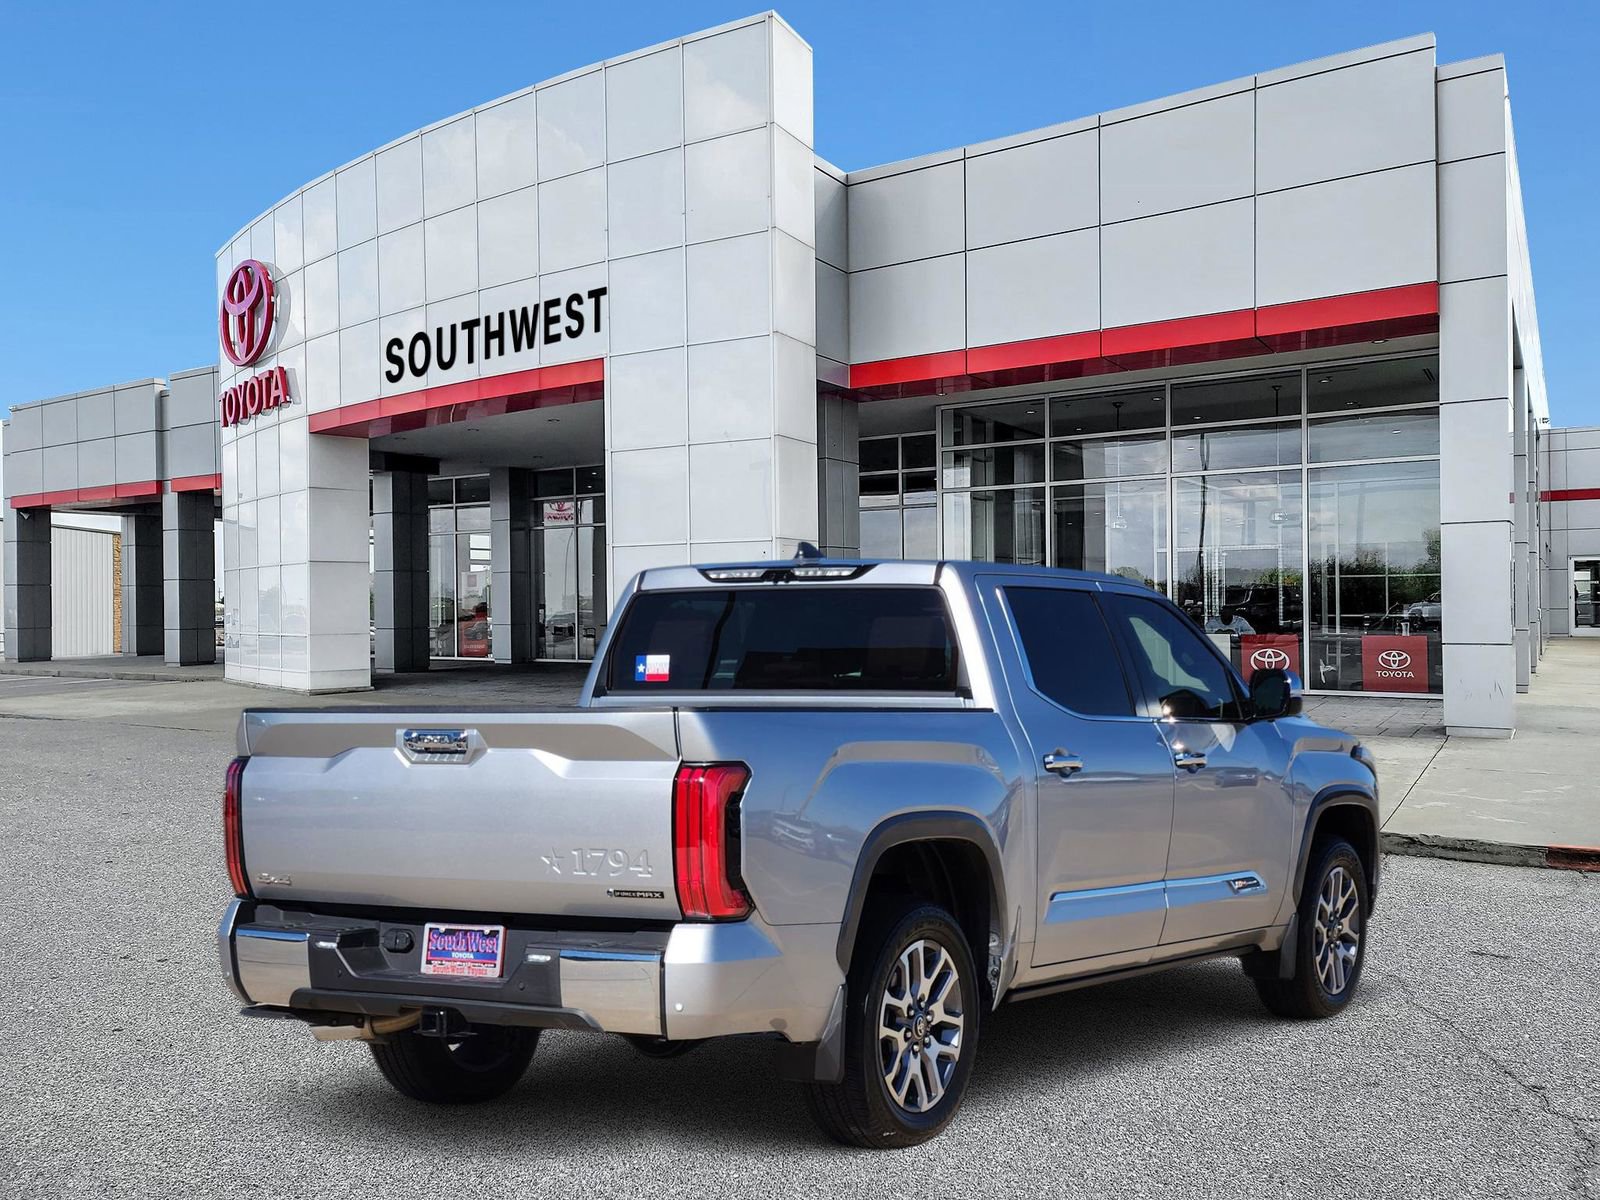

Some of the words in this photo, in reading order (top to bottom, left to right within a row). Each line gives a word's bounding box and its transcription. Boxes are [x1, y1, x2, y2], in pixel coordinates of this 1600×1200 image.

[385, 286, 607, 383] SOUTHWEST
[219, 366, 291, 428] TOYOTA
[1376, 670, 1414, 678] TOYOTA
[571, 848, 653, 877] 1794
